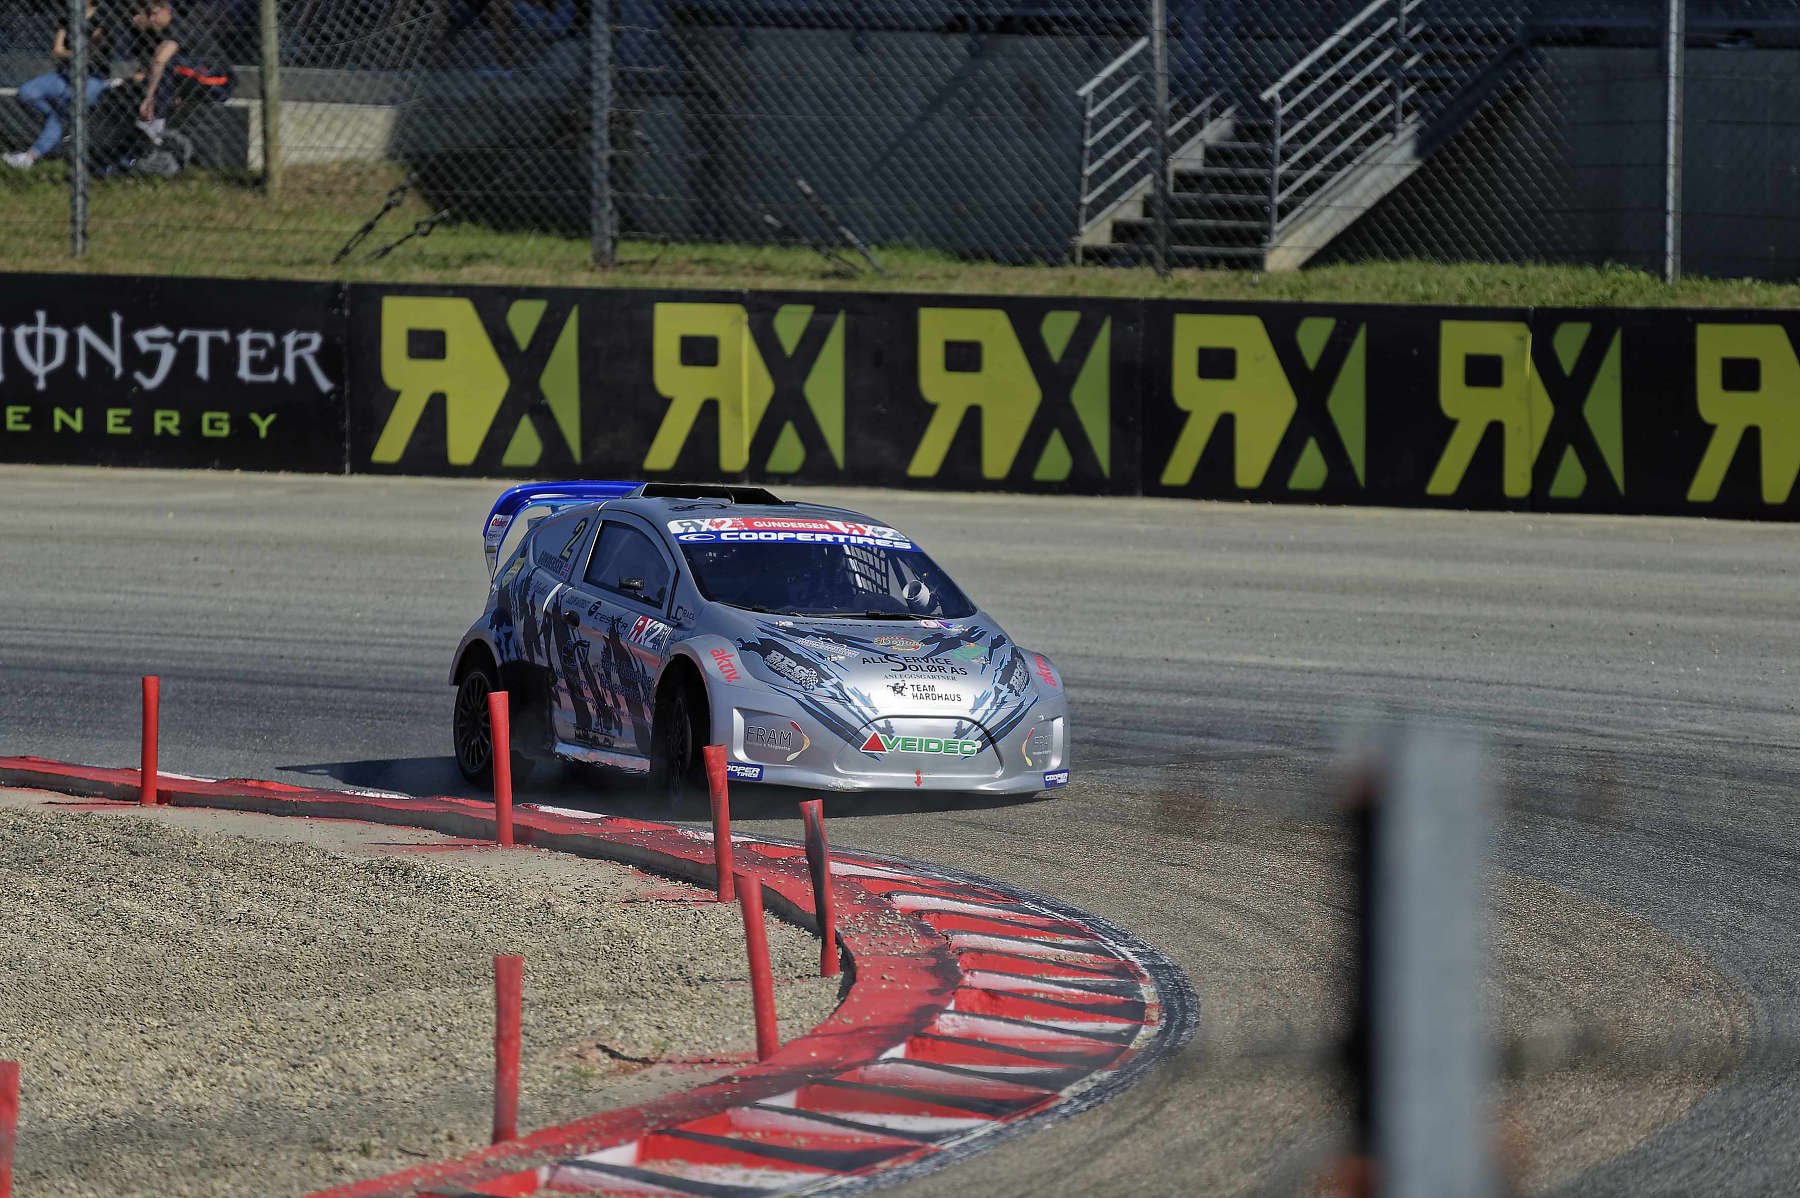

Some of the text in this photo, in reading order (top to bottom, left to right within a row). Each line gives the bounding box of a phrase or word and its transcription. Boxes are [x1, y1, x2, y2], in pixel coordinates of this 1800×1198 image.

[0, 310, 335, 393] ONSTER
[6, 405, 279, 438] ENERGY
[753, 520, 831, 530] GUNDERSEN
[557, 517, 588, 560] 2
[950, 666, 968, 676] AS
[910, 684, 936, 692] TEAM
[912, 692, 962, 702] HARDHAUS
[746, 726, 793, 746] FRAM
[880, 735, 976, 756] VEIDEC
